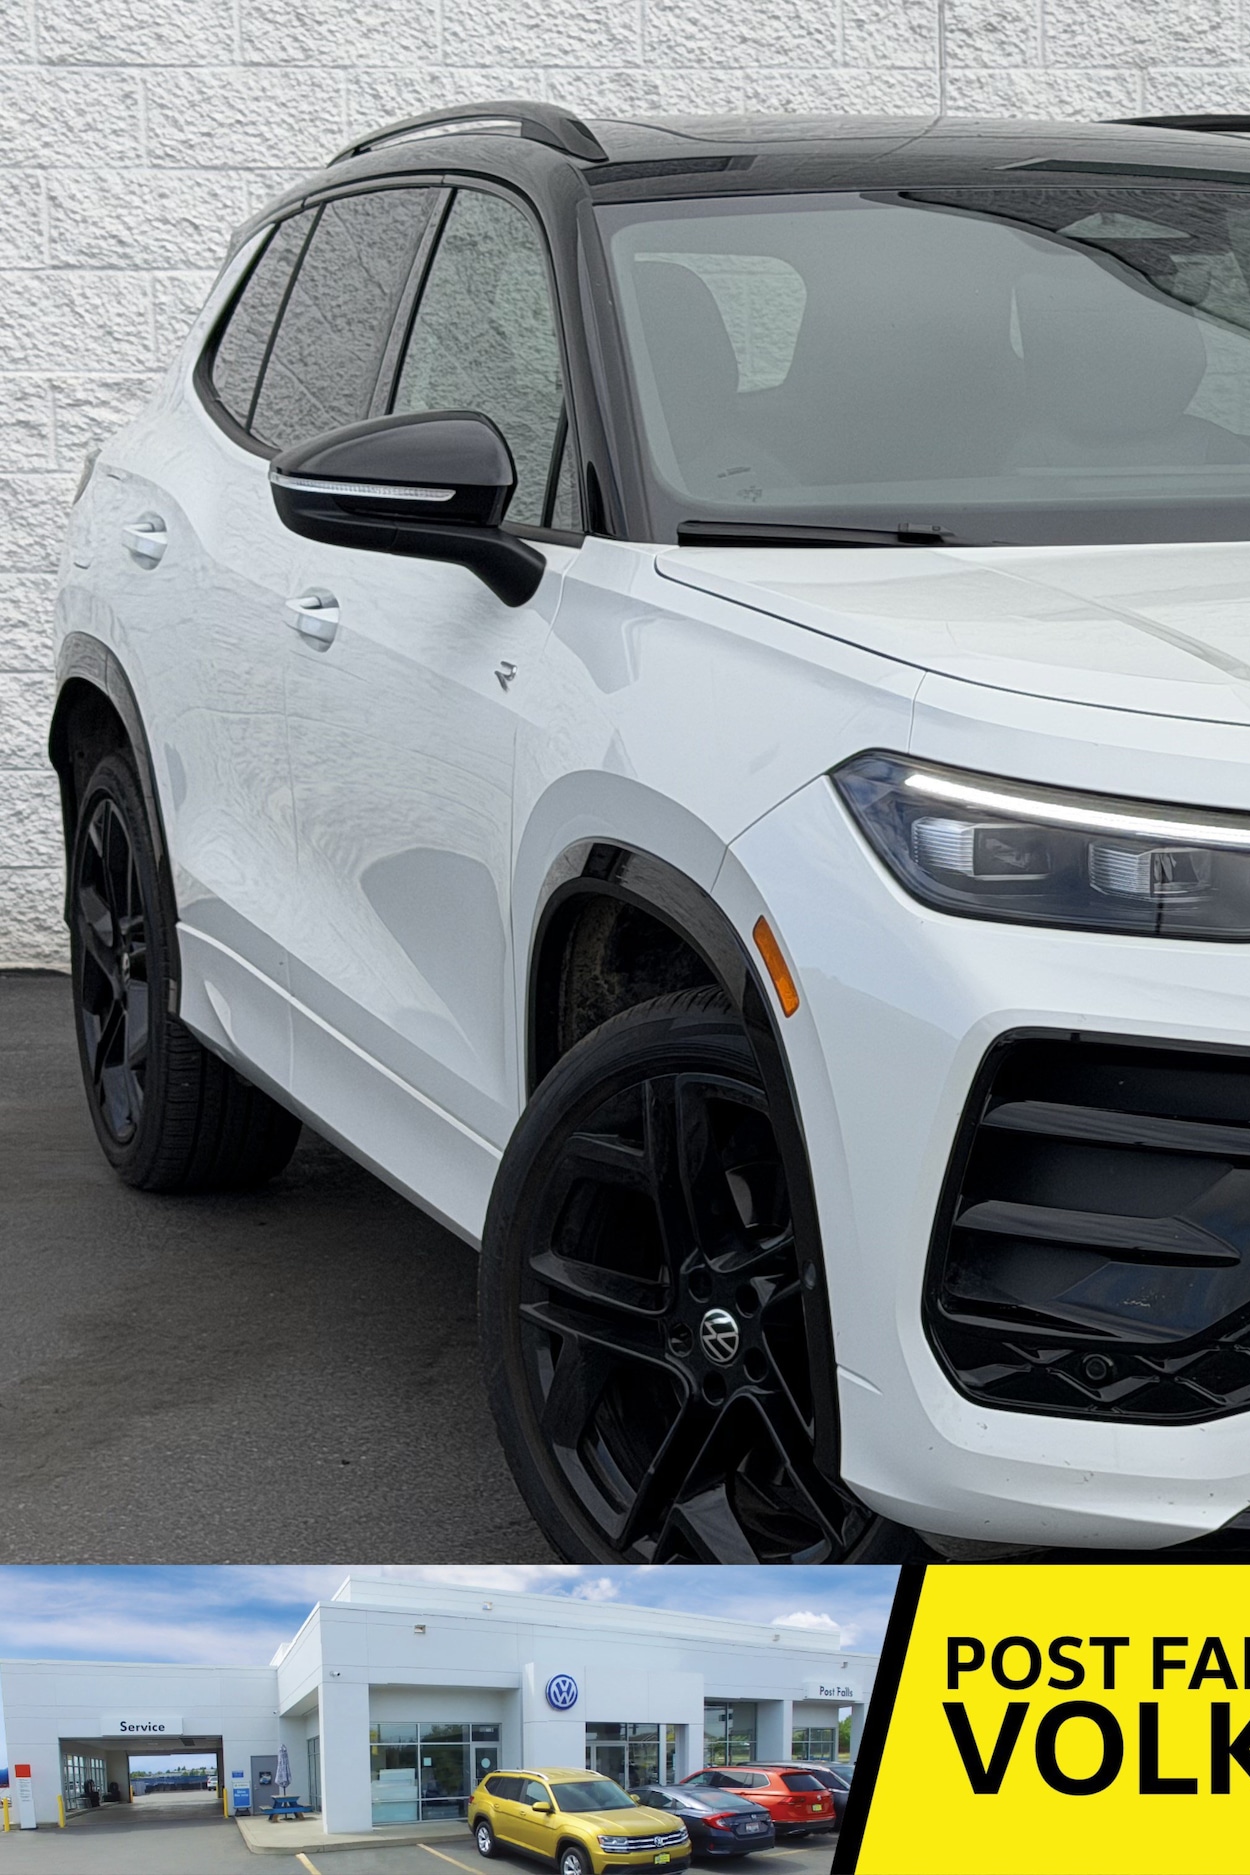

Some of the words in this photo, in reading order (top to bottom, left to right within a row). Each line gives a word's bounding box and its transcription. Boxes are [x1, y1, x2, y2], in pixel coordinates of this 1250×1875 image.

[819, 1685, 835, 1697] Post
[836, 1686, 853, 1697] Falls
[120, 1721, 165, 1732] Service
